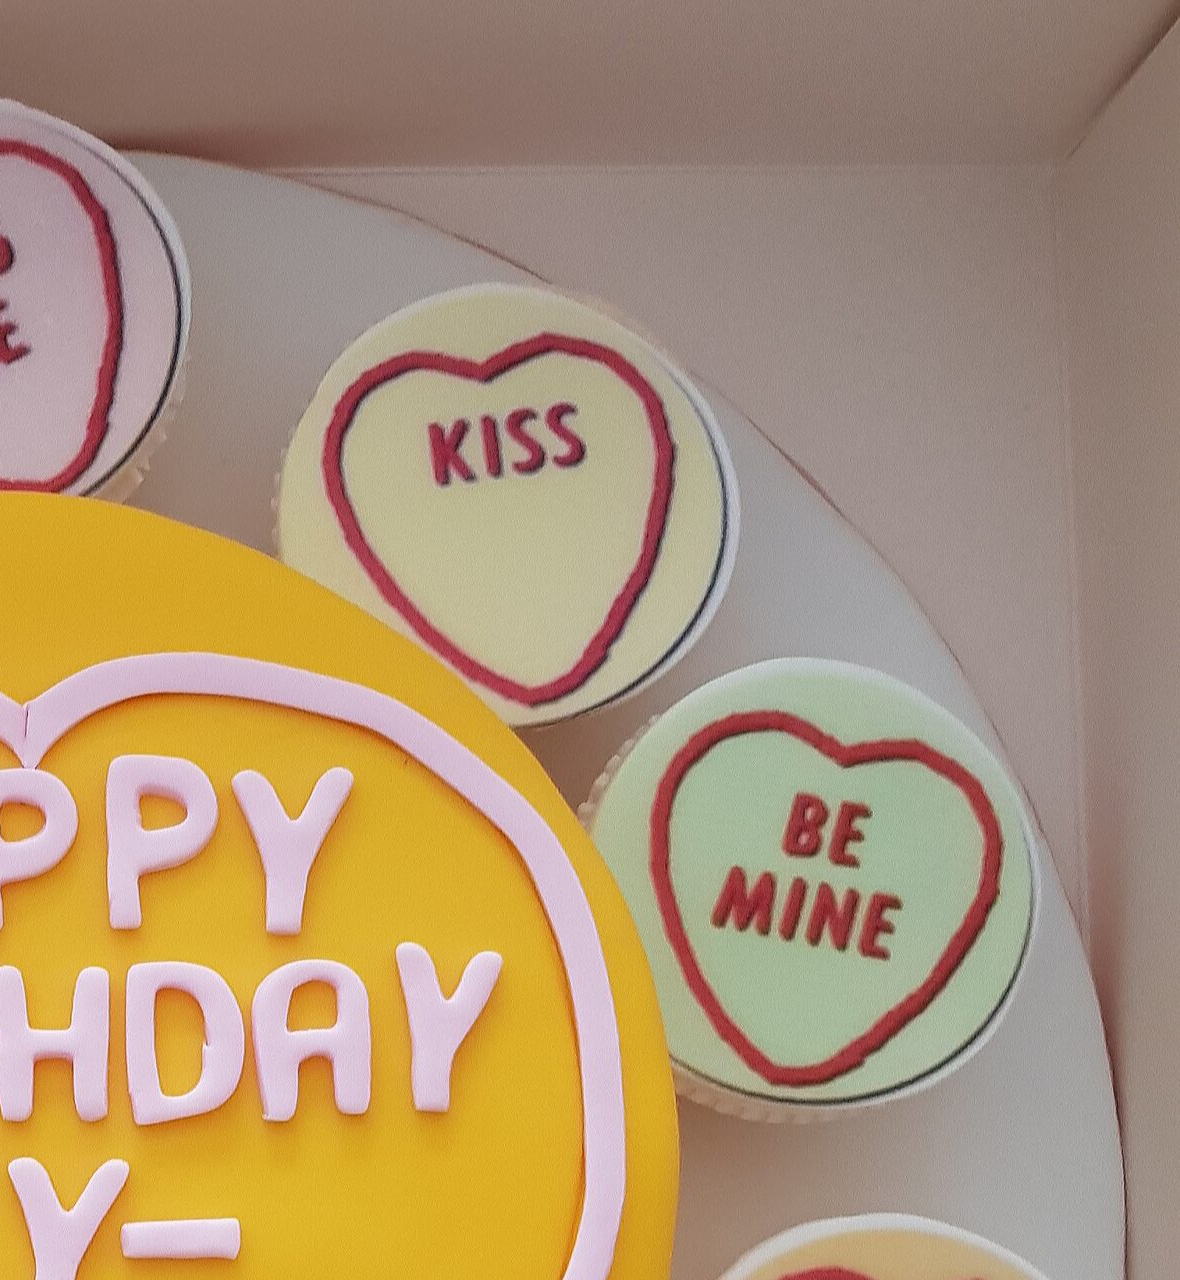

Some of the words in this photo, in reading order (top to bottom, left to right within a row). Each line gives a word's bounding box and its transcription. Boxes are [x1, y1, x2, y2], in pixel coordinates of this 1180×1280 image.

[428, 403, 587, 486] KISS
[783, 793, 873, 868] BE
[712, 866, 903, 960] MINE
